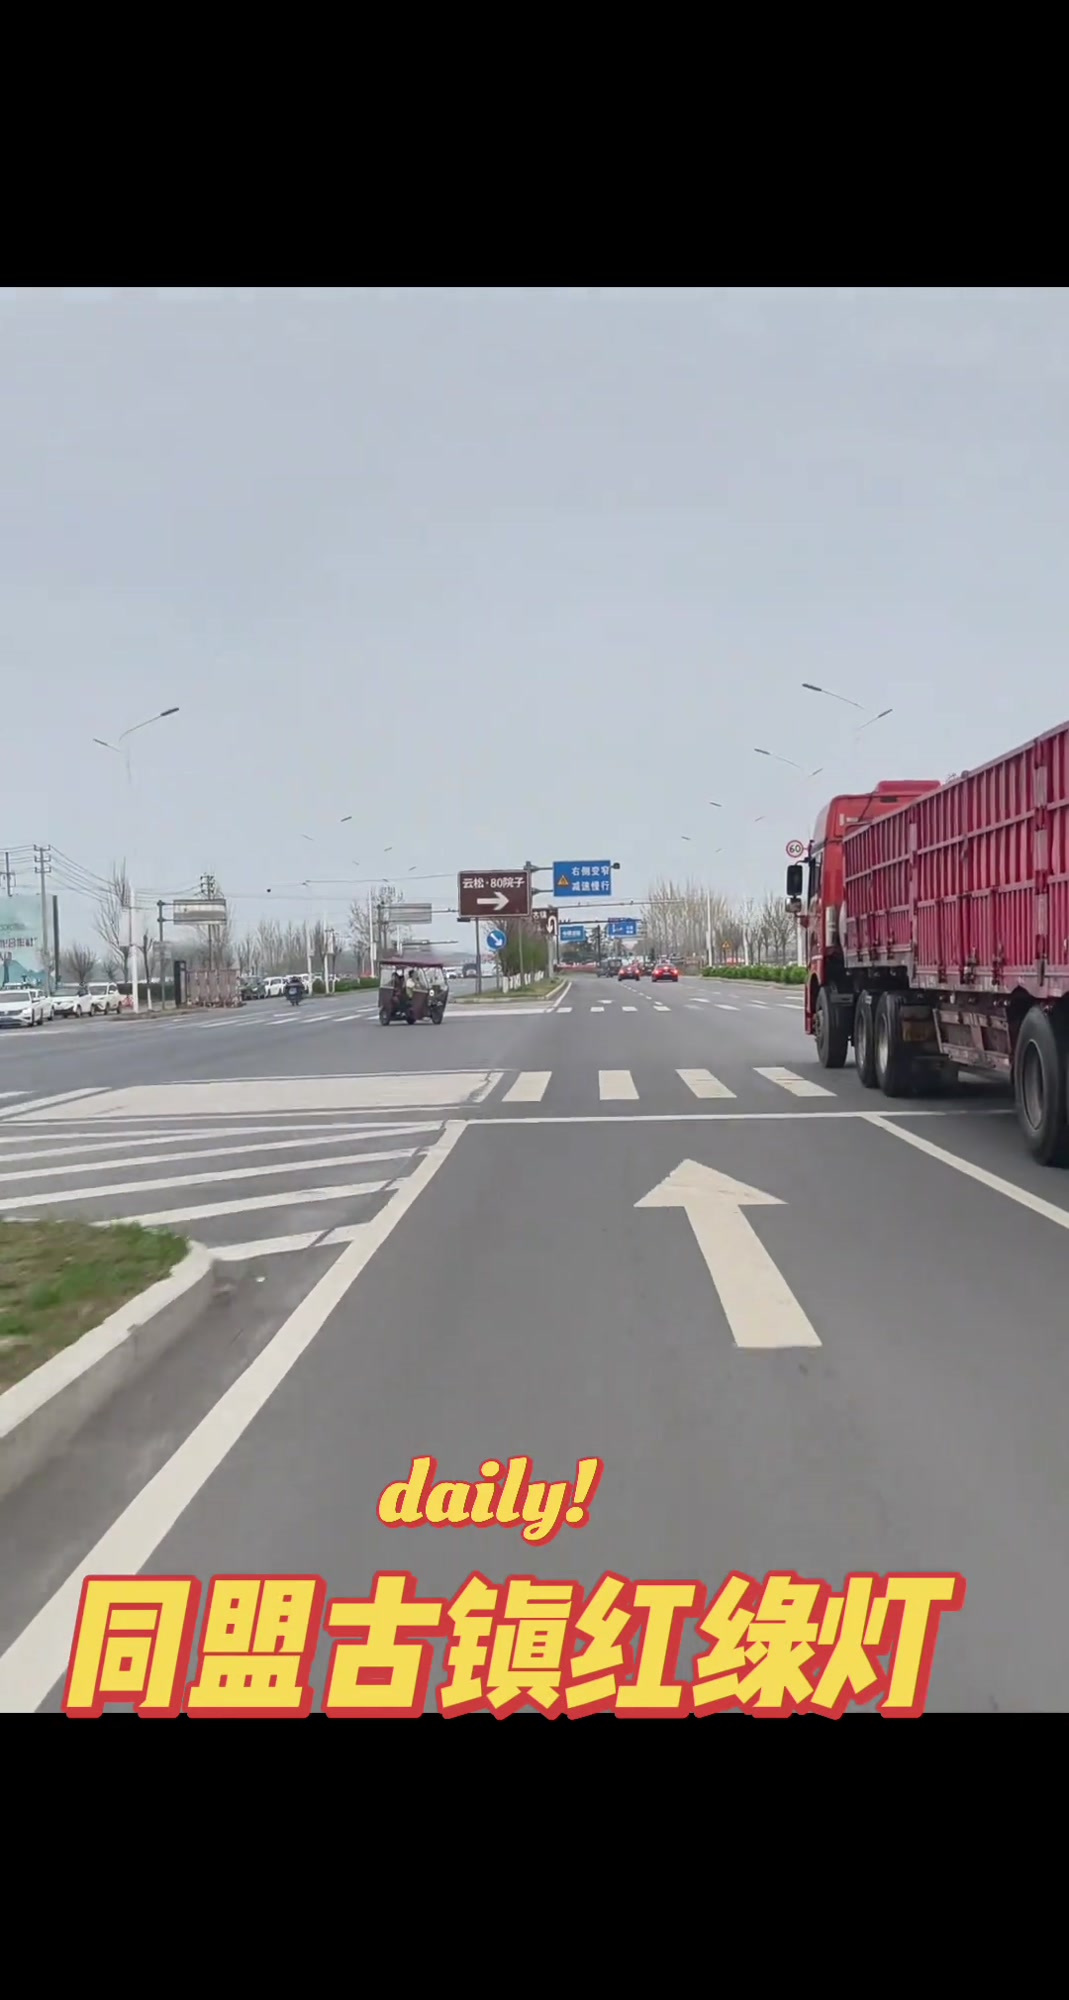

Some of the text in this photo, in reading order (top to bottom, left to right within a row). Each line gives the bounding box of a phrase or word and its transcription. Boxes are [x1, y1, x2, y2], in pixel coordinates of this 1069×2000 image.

[789, 844, 801, 853] 60
[571, 881, 609, 891] 减速慢行
